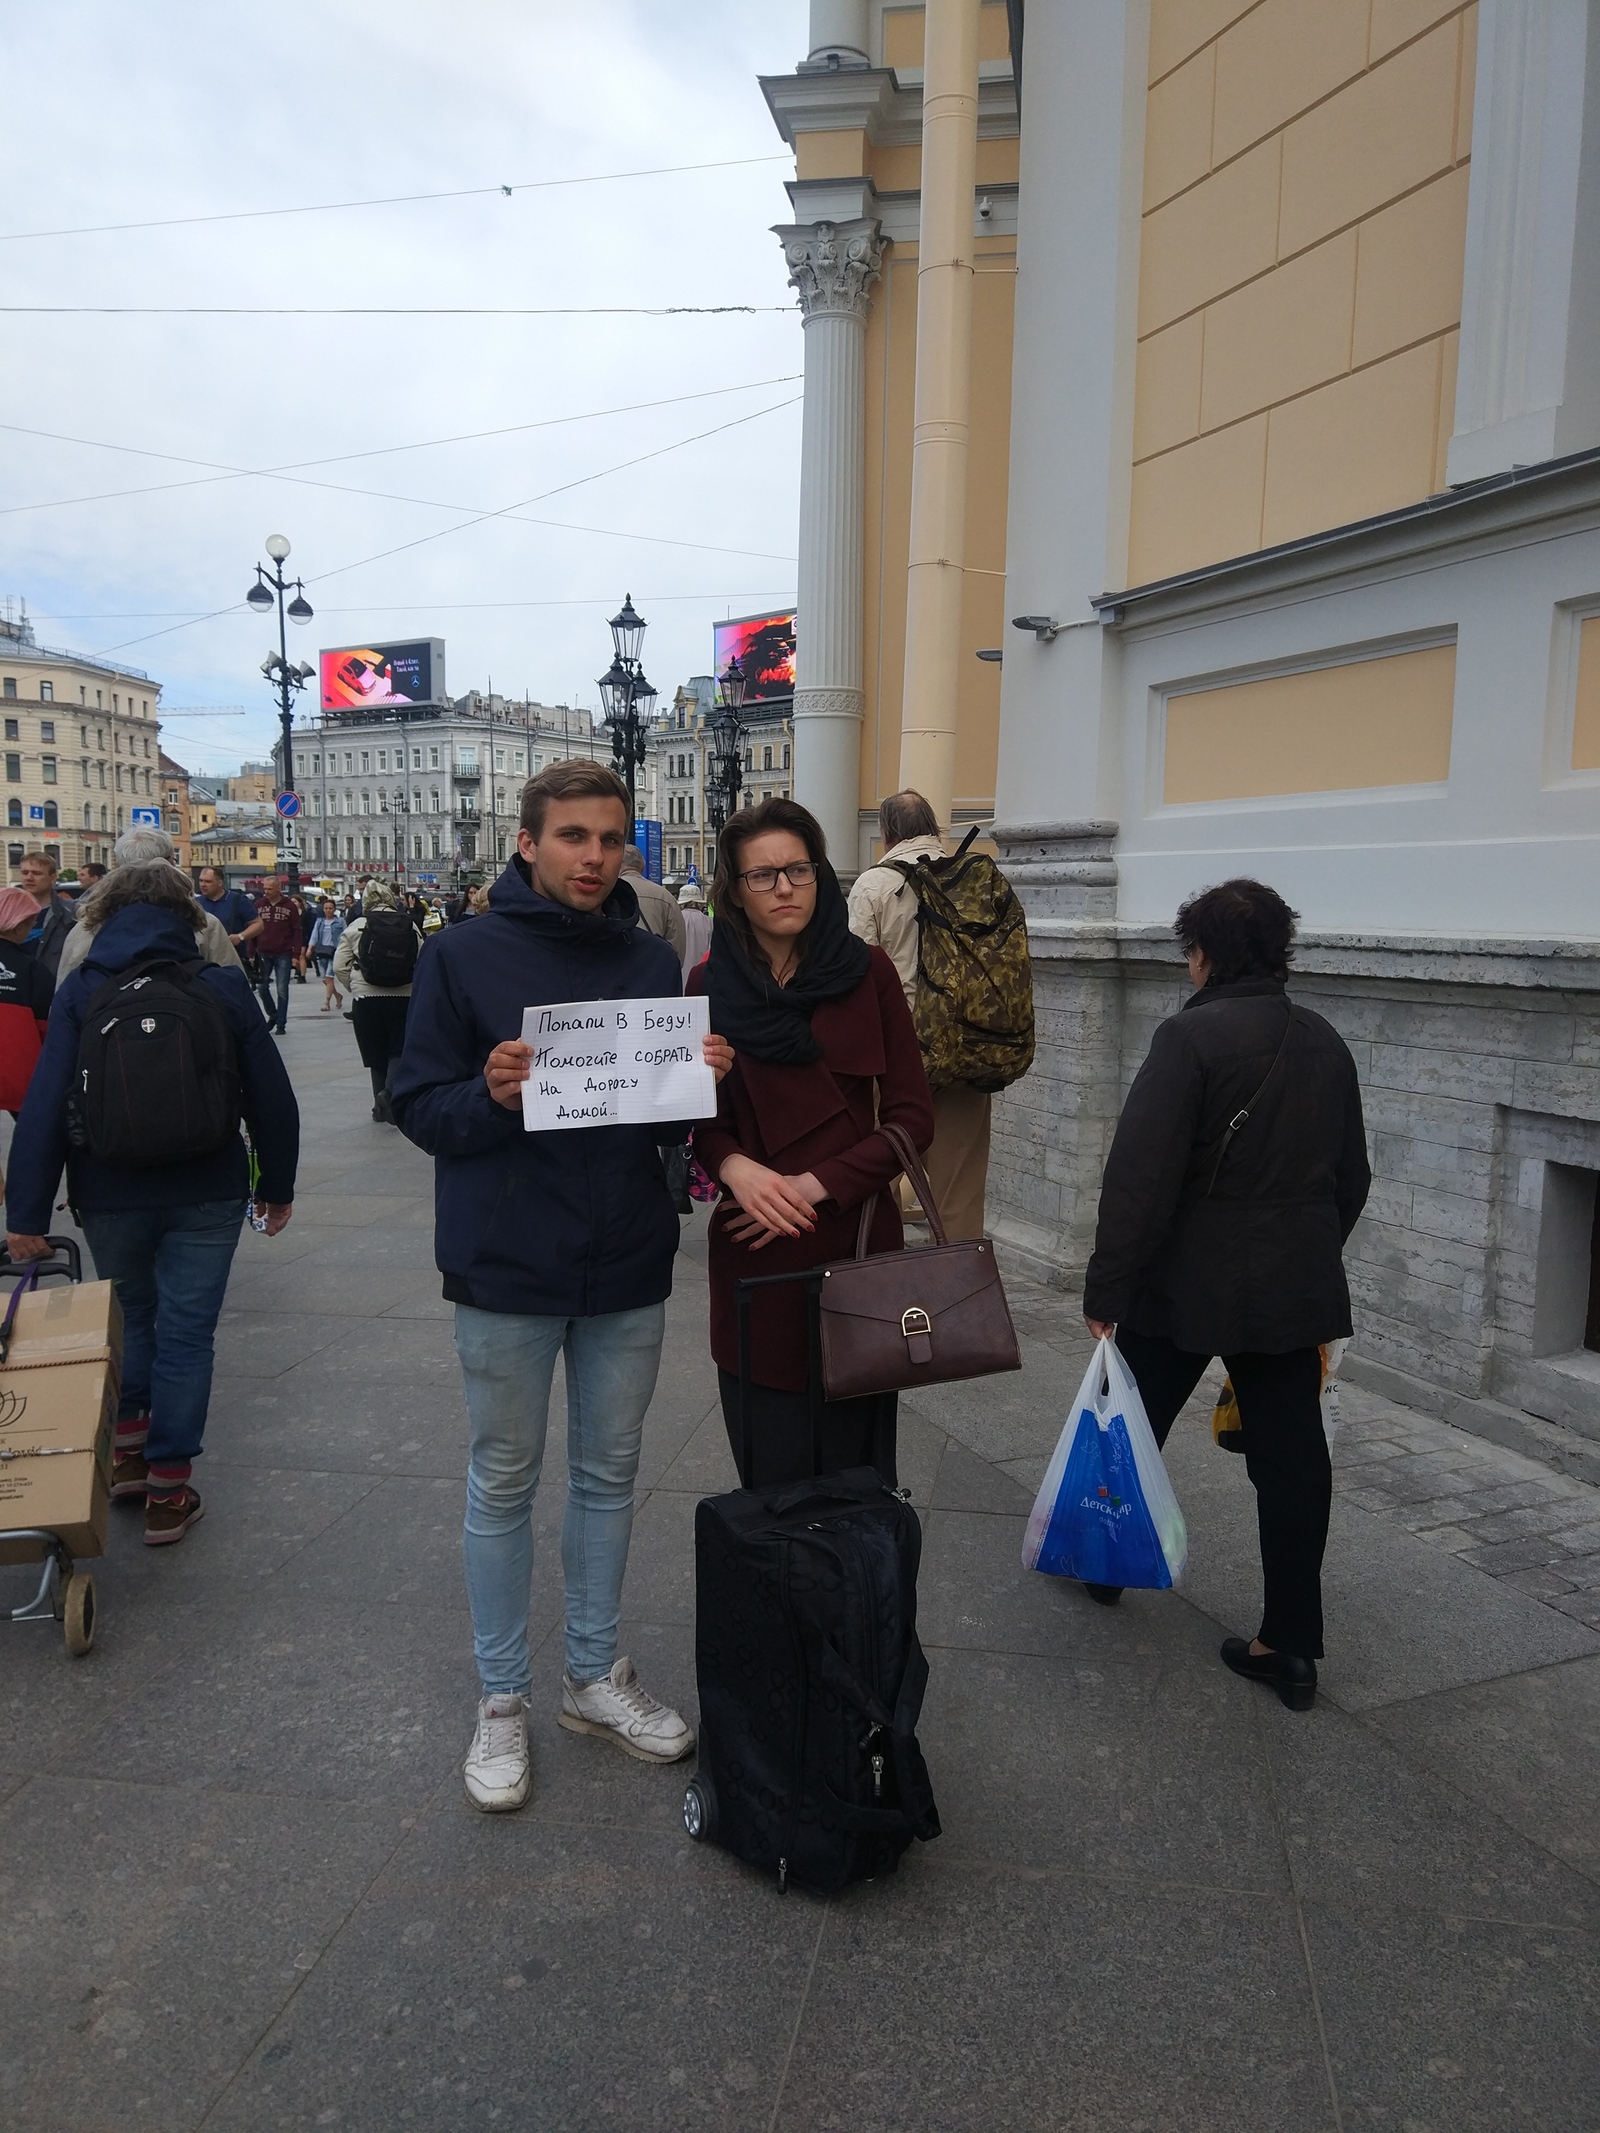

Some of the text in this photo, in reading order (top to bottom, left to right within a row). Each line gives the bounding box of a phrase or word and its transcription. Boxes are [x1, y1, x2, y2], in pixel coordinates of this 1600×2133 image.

[538, 1011, 605, 1034] Попали
[644, 1009, 691, 1032] Беду!
[535, 1047, 618, 1068] Помогите
[540, 1081, 562, 1096] На
